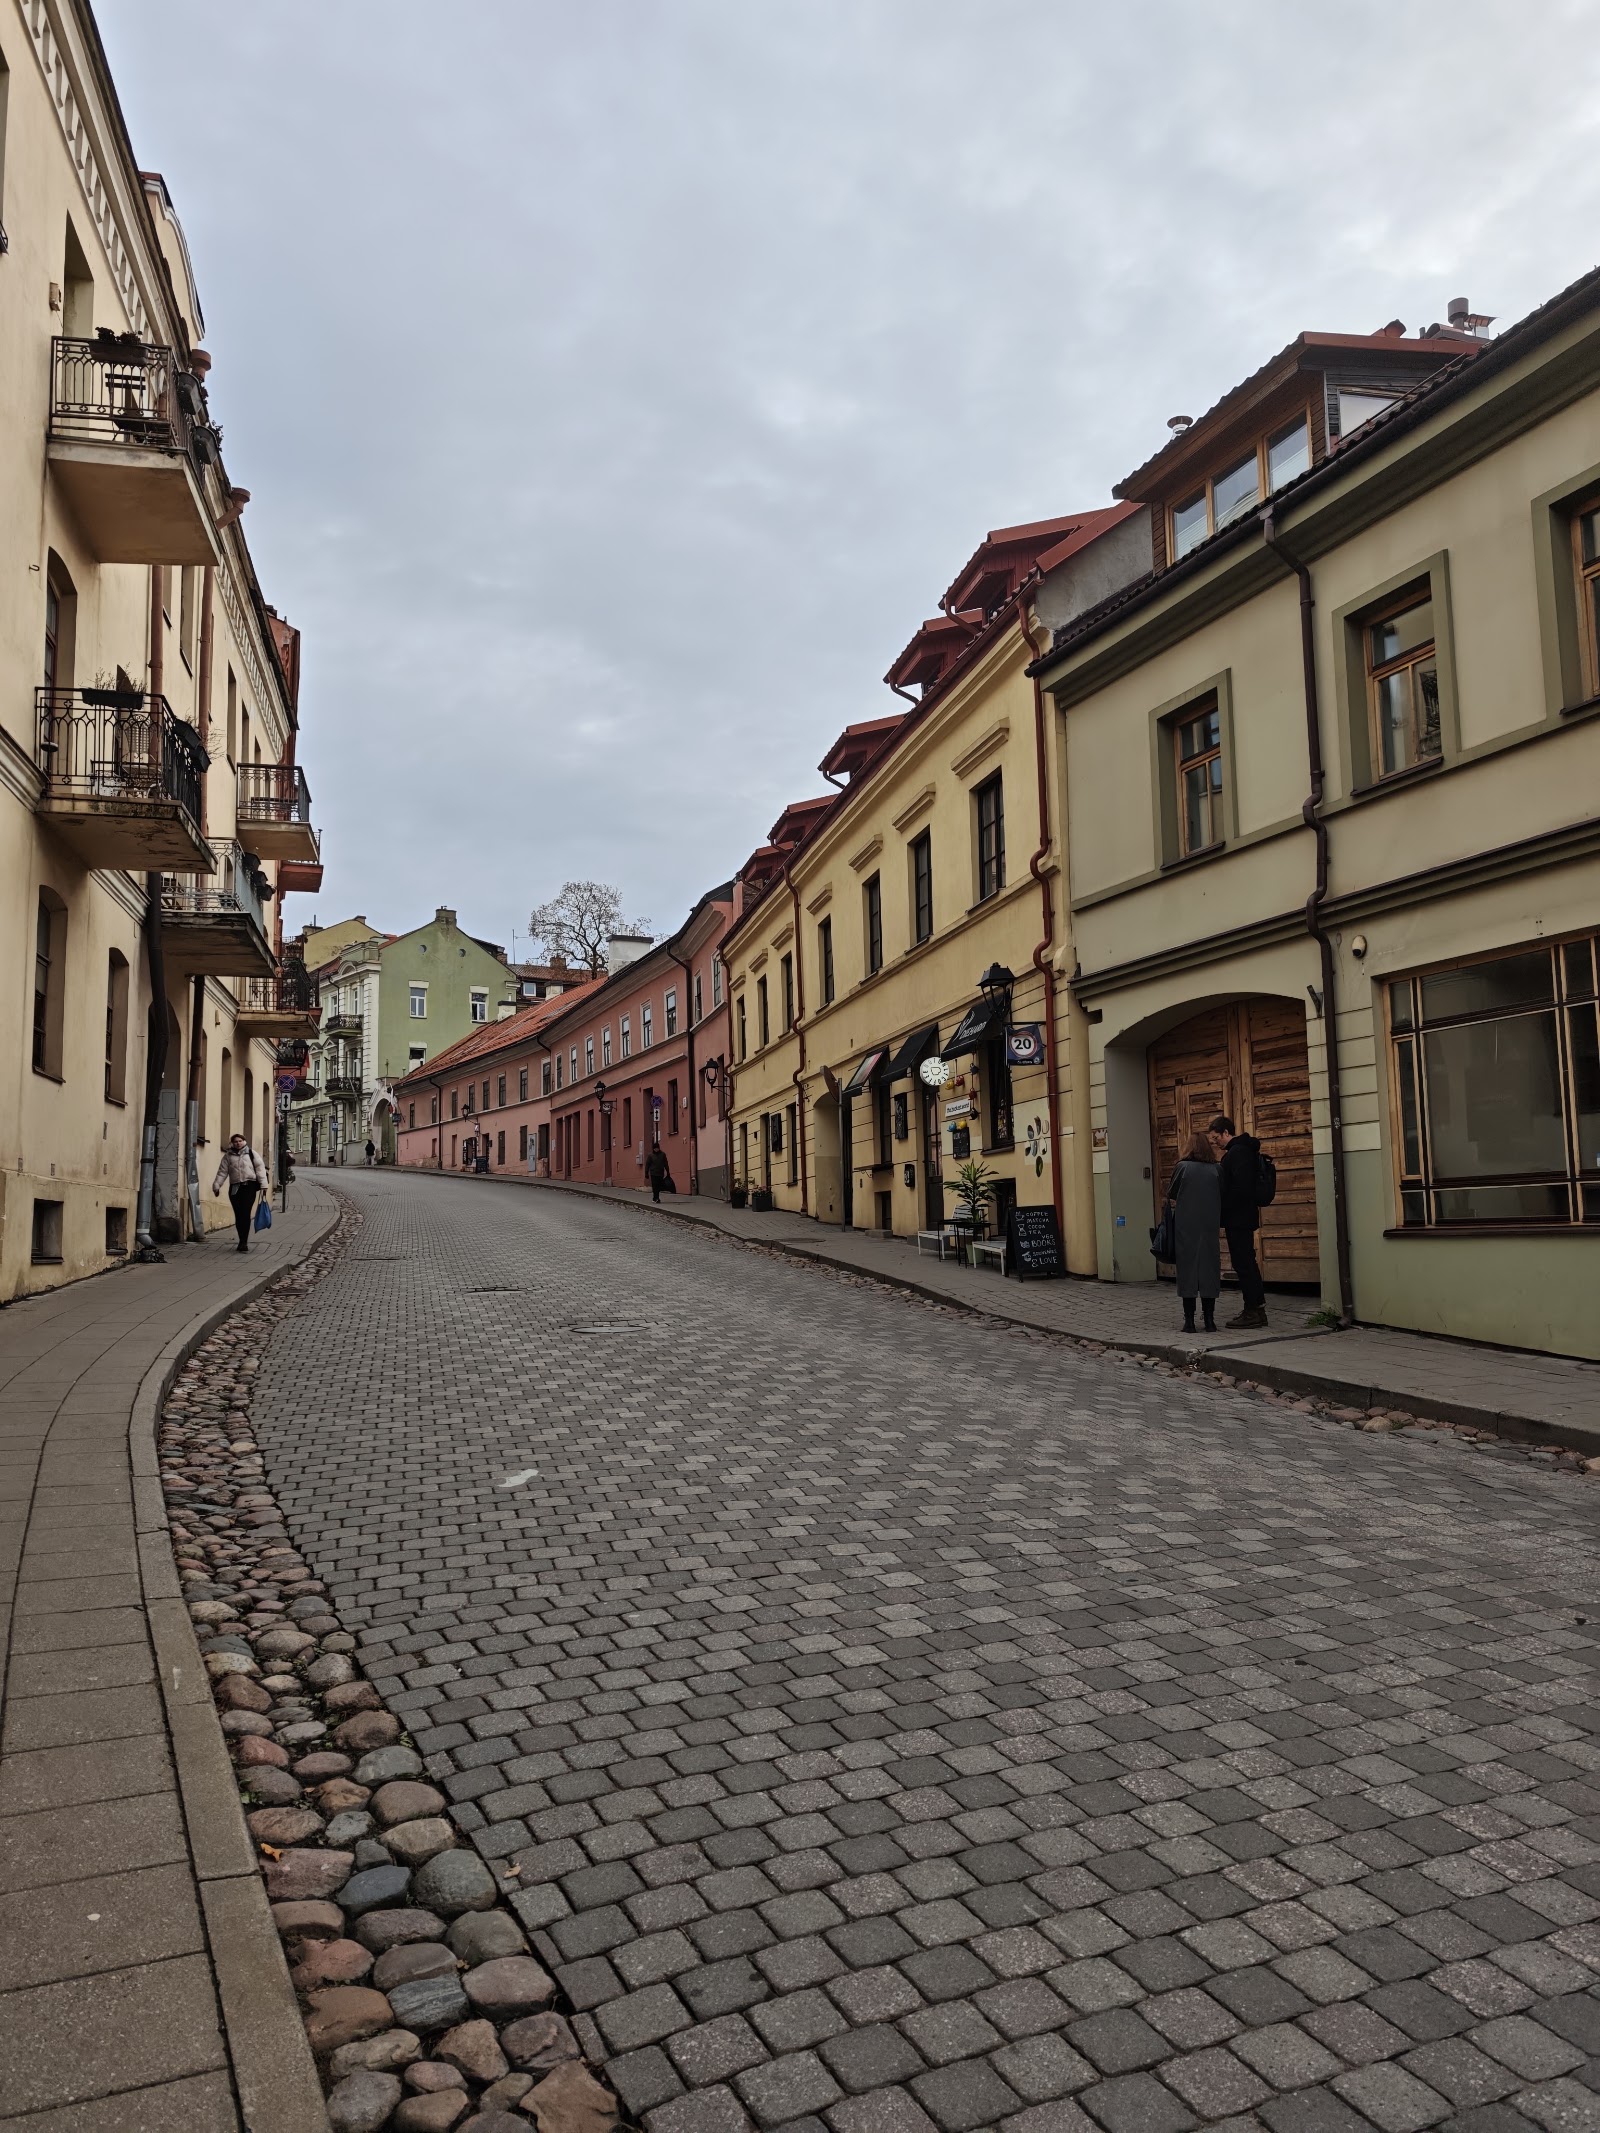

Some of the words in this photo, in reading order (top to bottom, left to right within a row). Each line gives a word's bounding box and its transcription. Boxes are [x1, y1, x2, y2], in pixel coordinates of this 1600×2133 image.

[1014, 1038, 1032, 1050] 20
[1031, 1239, 1055, 1247] BOOKS
[1039, 1256, 1057, 1264] LOVE
